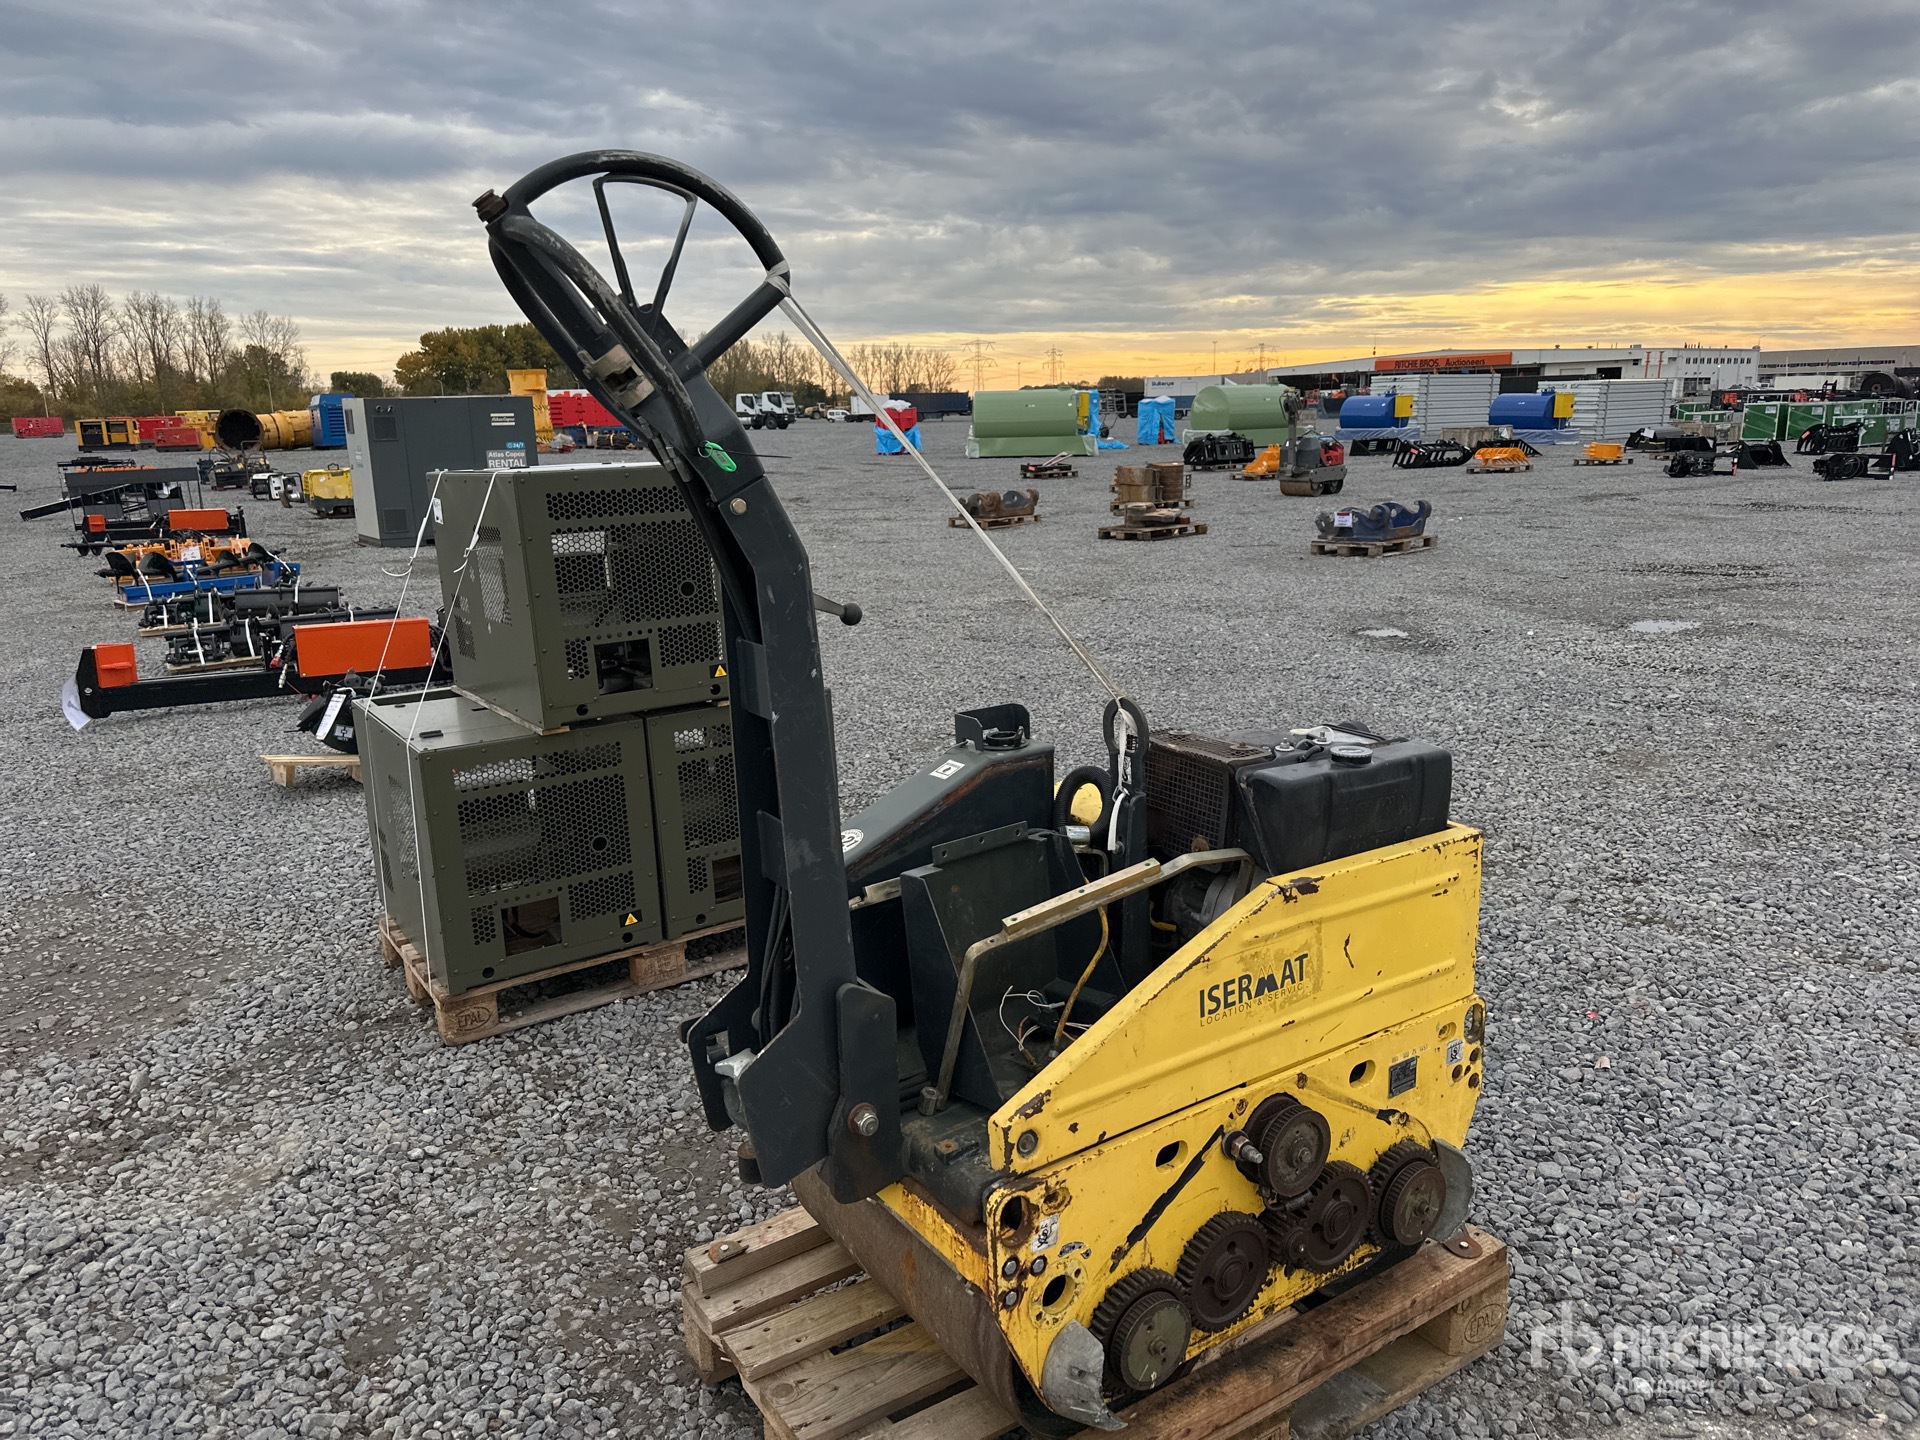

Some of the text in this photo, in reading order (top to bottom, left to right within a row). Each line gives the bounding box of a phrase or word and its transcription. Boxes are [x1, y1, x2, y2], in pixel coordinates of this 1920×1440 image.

[1394, 358, 1486, 368] RITCHIE BROS. Auctioneers
[488, 459, 526, 468] RENTAL
[1199, 953, 1309, 1019] ISERMAT
[1200, 1002, 1252, 1028] LOCATION
[1257, 998, 1263, 1006] &
